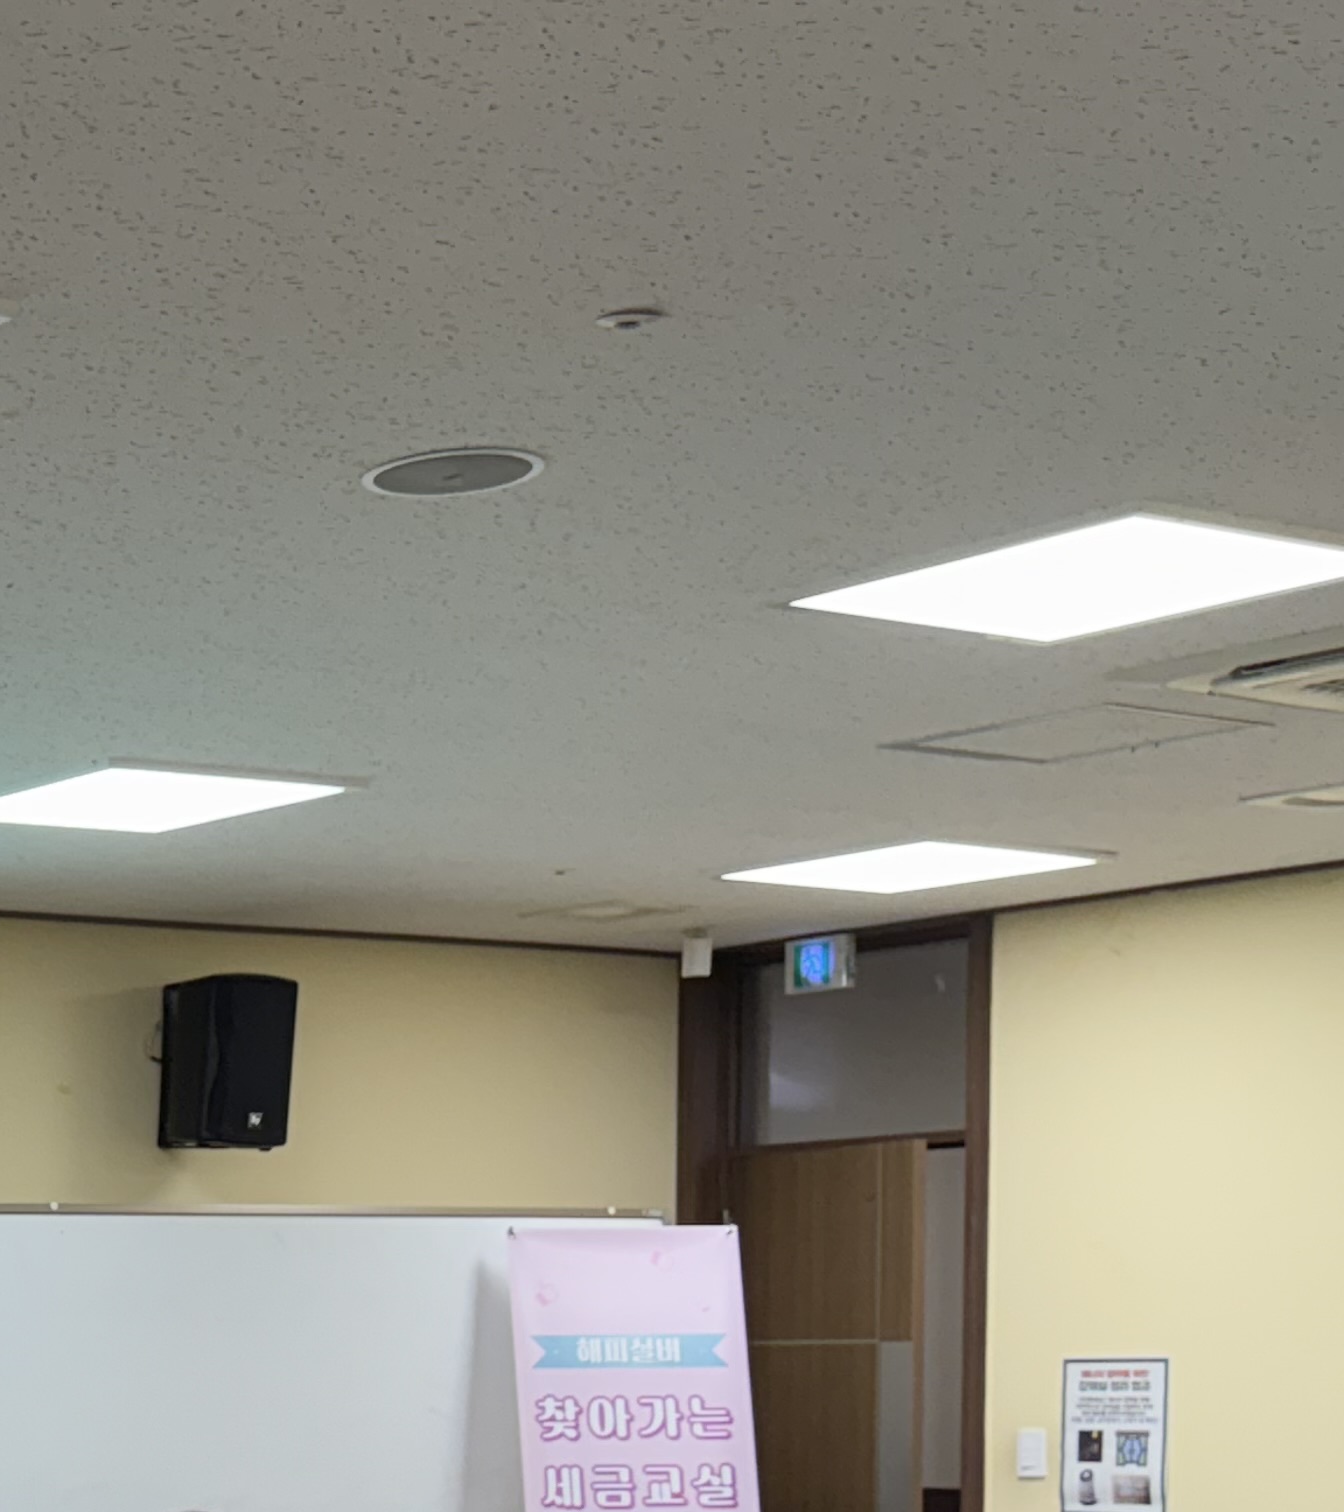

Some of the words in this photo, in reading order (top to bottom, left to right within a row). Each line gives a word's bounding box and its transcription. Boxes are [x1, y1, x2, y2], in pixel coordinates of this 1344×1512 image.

[576, 1336, 681, 1364] 해피실버
[535, 1394, 734, 1441] 찾아가는
[541, 1463, 739, 1509] 세금교실
